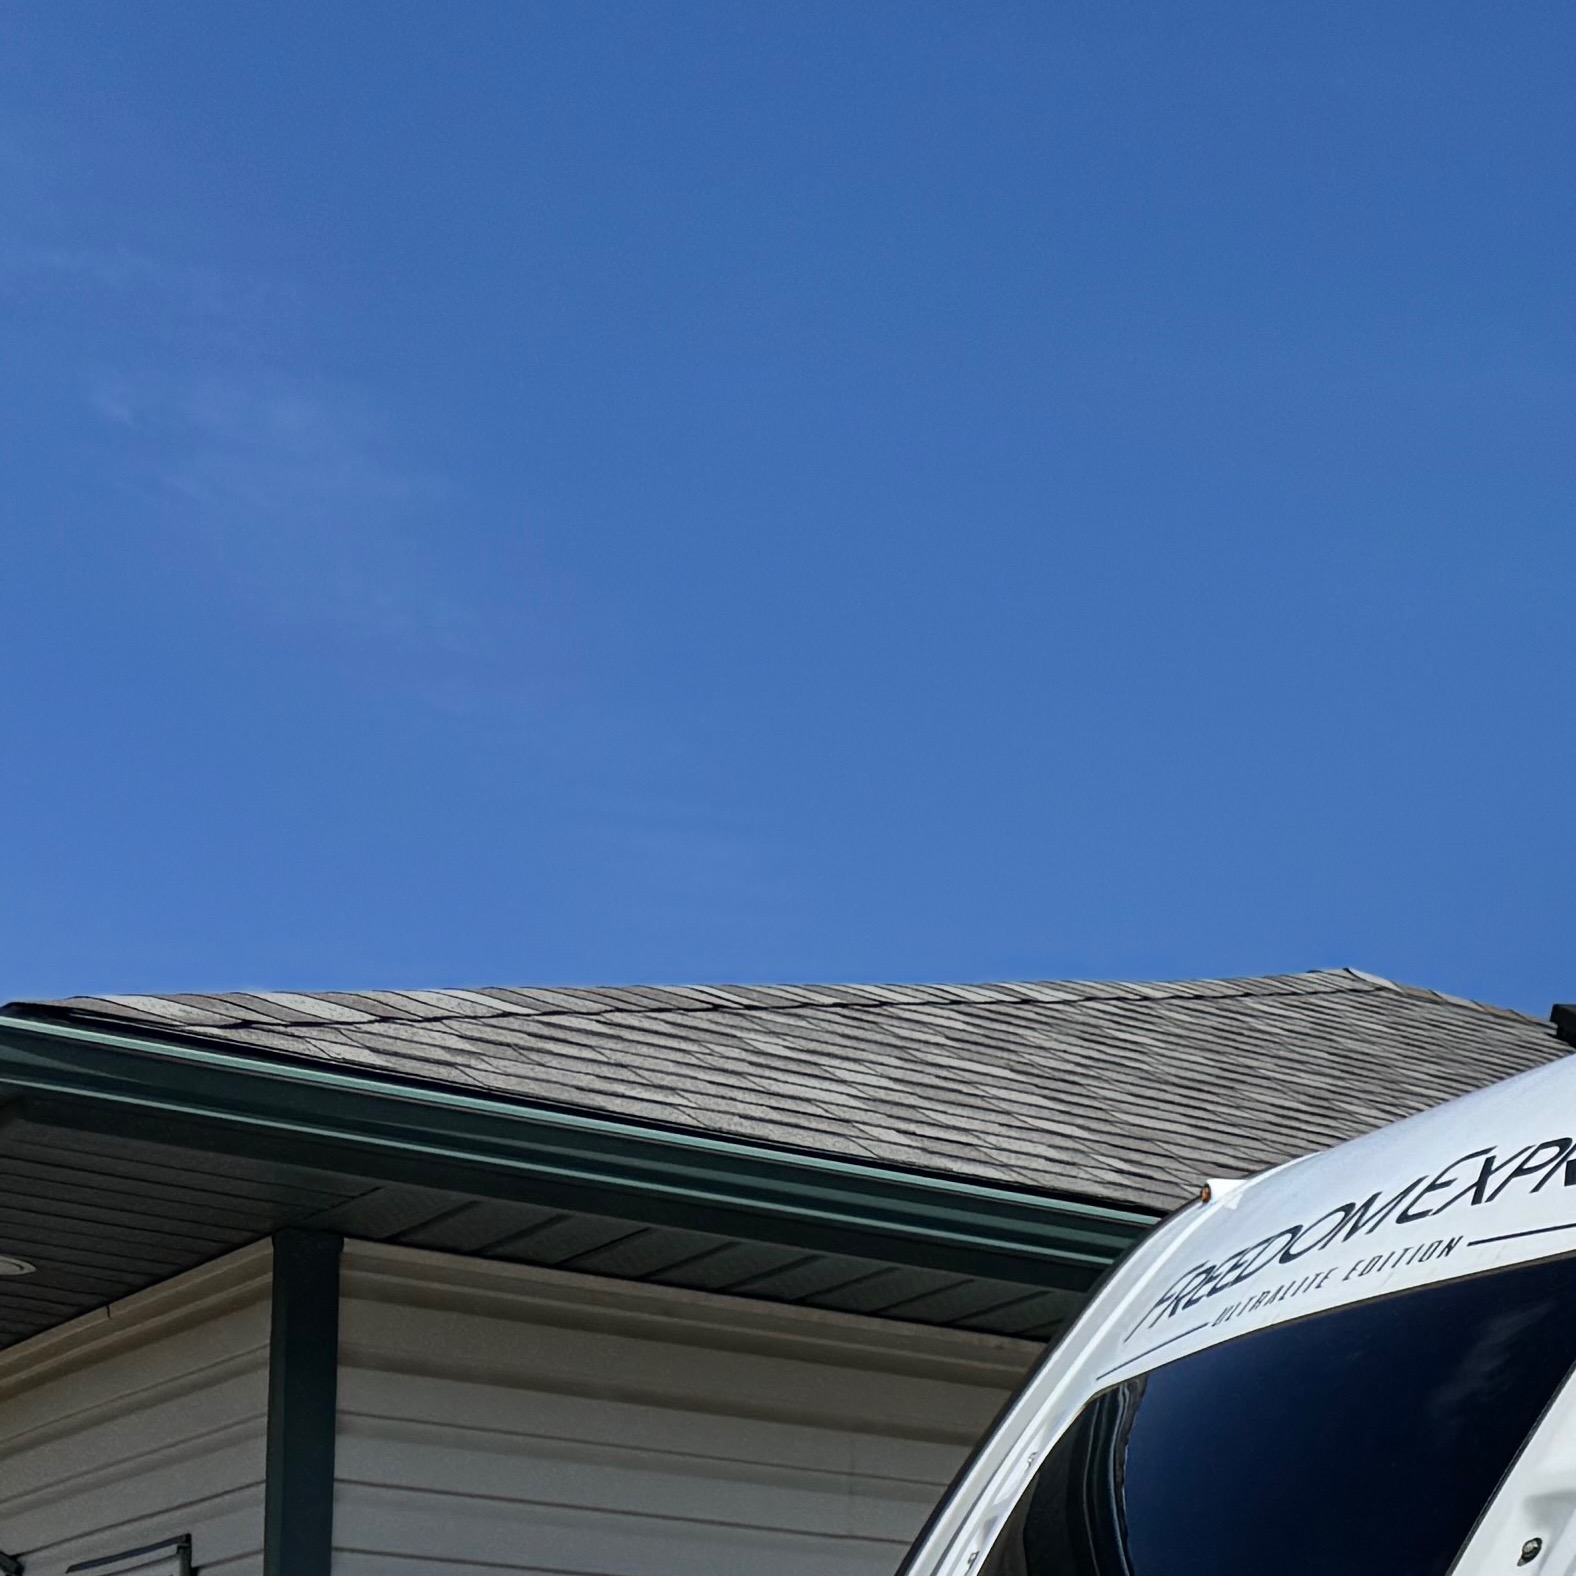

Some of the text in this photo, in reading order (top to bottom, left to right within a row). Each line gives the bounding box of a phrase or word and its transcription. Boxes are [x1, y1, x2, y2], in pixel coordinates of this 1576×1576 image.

[1123, 1174, 1429, 1344] FREEDOM
[1211, 1234, 1464, 1327] ULTRALITE EDITION
